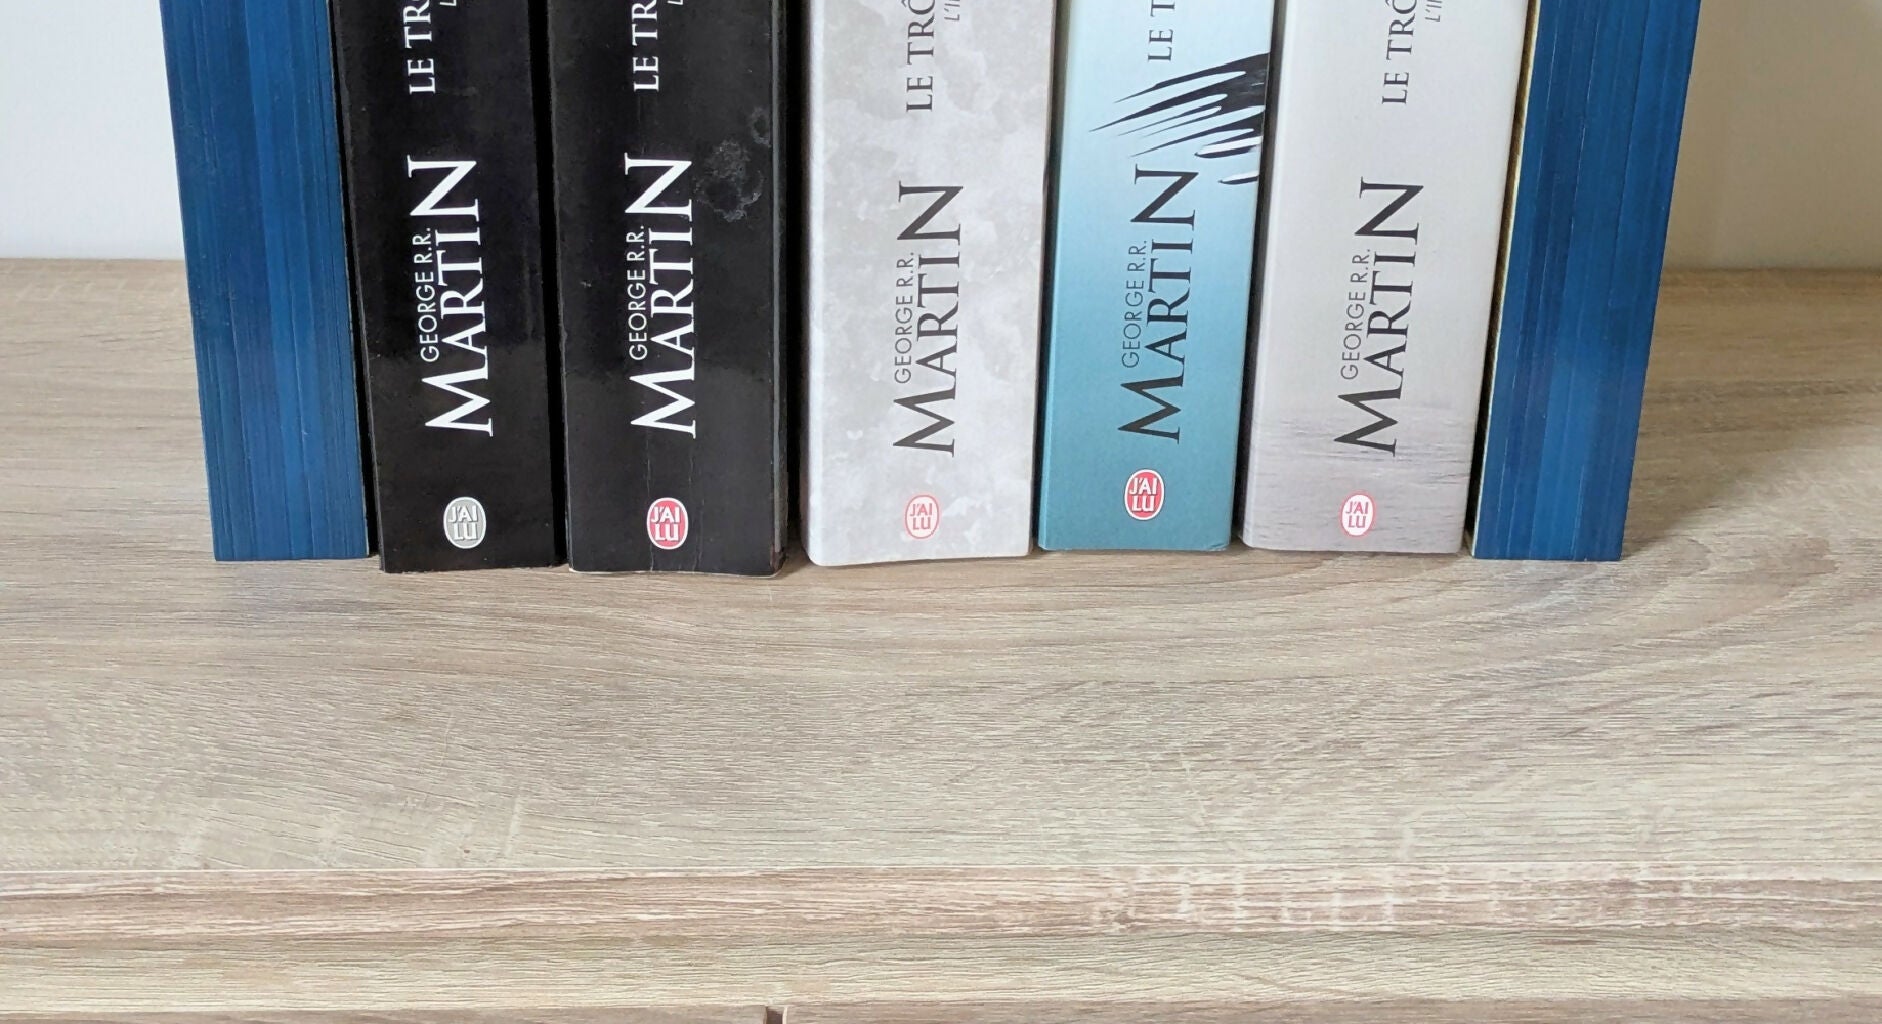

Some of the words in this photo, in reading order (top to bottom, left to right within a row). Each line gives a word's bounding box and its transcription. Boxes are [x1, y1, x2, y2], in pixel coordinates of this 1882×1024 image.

[1147, 28, 1174, 62] LE
[406, 57, 437, 95] LE
[631, 55, 660, 93] LE
[1381, 71, 1410, 105] LE
[905, 75, 934, 113] LE
[411, 226, 434, 264] R.R.
[625, 226, 646, 262] R.R.
[1126, 241, 1147, 272] R.R.
[895, 252, 914, 288] R.R.
[1349, 249, 1370, 283] R.R.
[406, 153, 494, 438] MARTIN
[623, 151, 697, 440] MARTIN
[1117, 163, 1200, 445] MARTIN
[414, 270, 440, 363] GEORGE
[626, 269, 648, 361] GEORGE
[892, 180, 964, 458] MARTIN
[1121, 280, 1145, 369] GEORGE
[1332, 176, 1425, 458] MARTIN
[894, 295, 914, 384] GEORGE
[1340, 291, 1367, 380] GEORGE
[1131, 494, 1155, 513] LU
[1348, 515, 1366, 528] LU
[453, 523, 478, 540] LU
[655, 523, 680, 541] LU
[912, 516, 931, 531] LU
